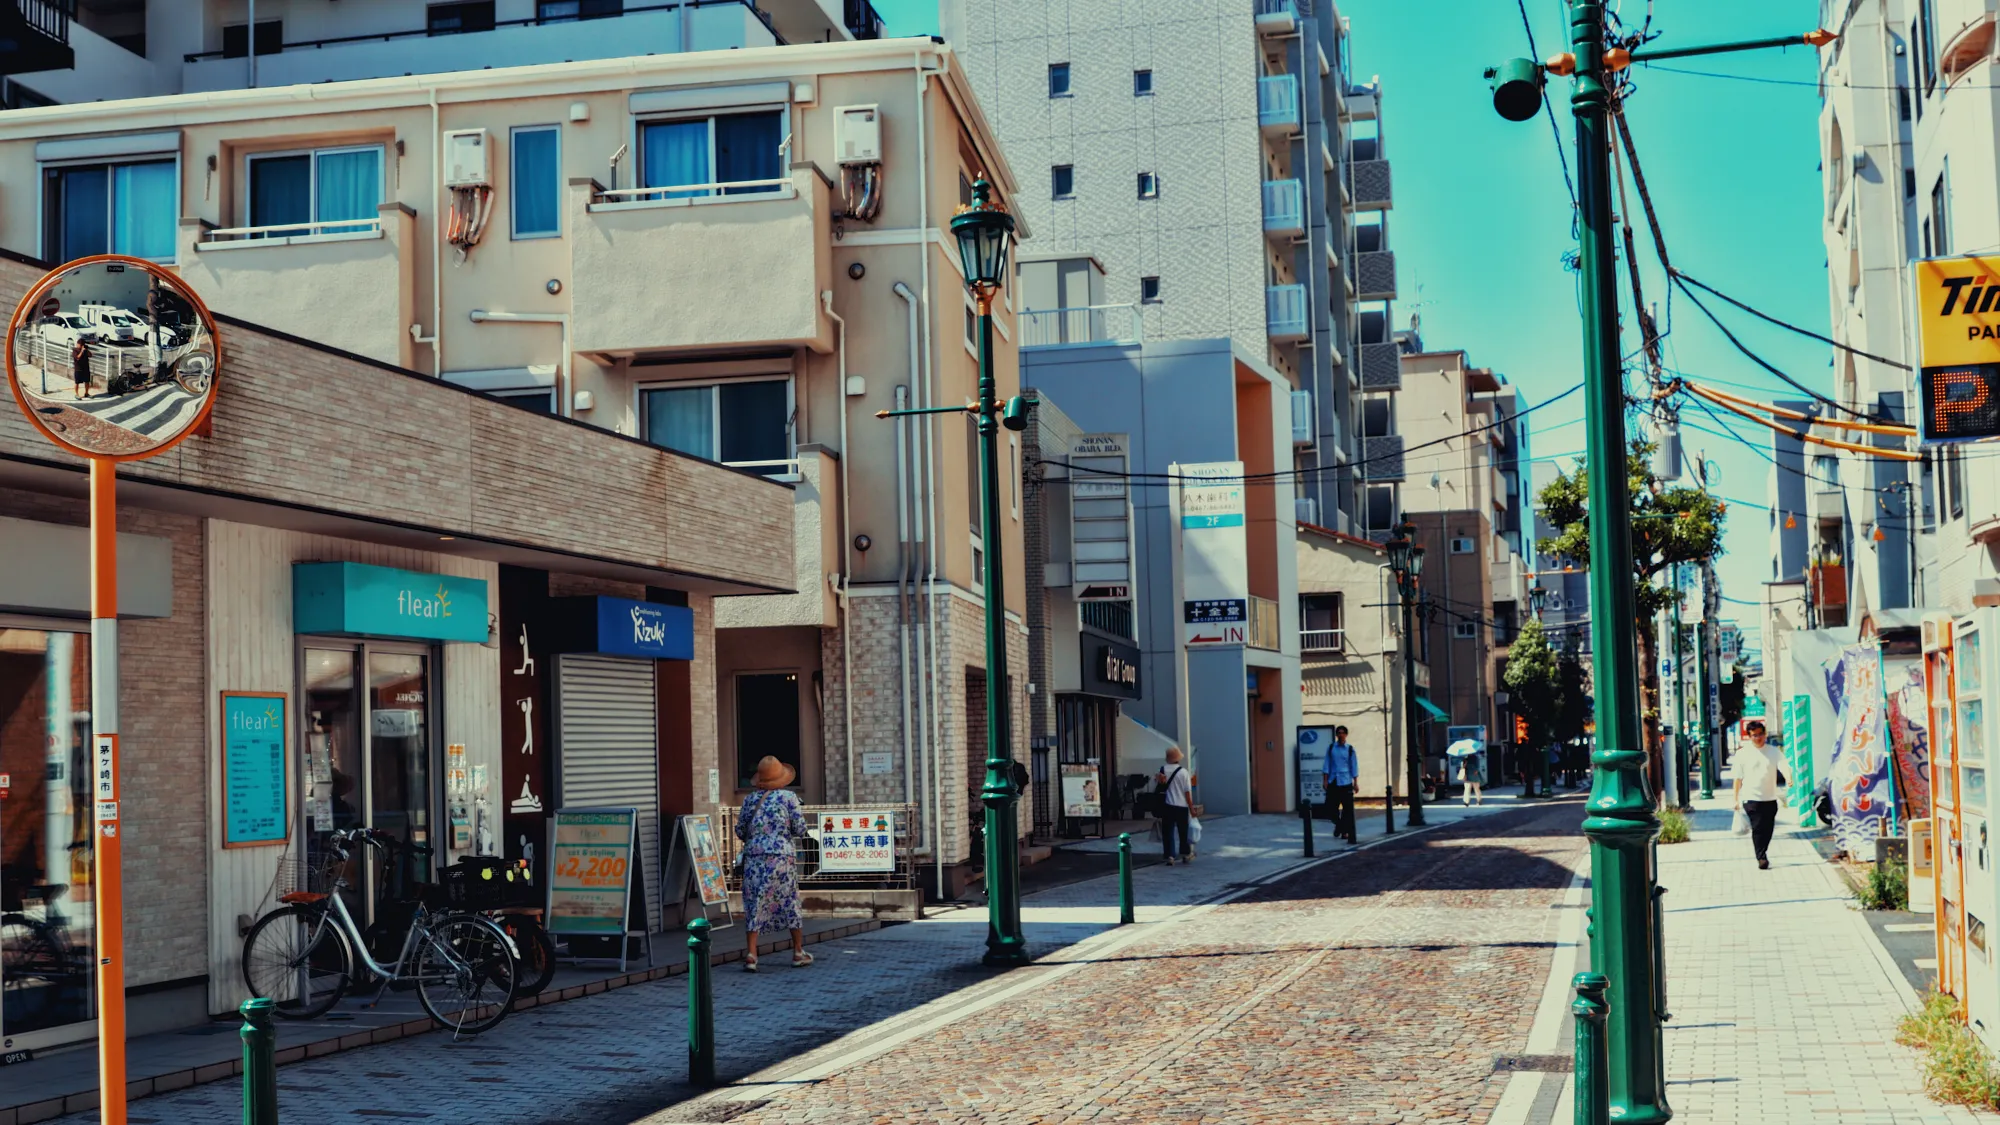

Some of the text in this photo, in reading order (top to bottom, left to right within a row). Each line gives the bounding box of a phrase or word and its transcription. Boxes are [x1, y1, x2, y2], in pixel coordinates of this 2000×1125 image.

[1933, 371, 1989, 432] P
[1082, 437, 1115, 445] SHONAN
[1074, 445, 1102, 453] OBARA
[1206, 516, 1220, 526] 2F
[1109, 587, 1124, 597] IN
[1224, 627, 1244, 642] IN
[233, 711, 268, 730] flear
[842, 817, 870, 829] 管理
[833, 850, 889, 860] 0467-82-2063
[556, 857, 627, 879] ¥2,200
[5, 1052, 27, 1064] OPEN
